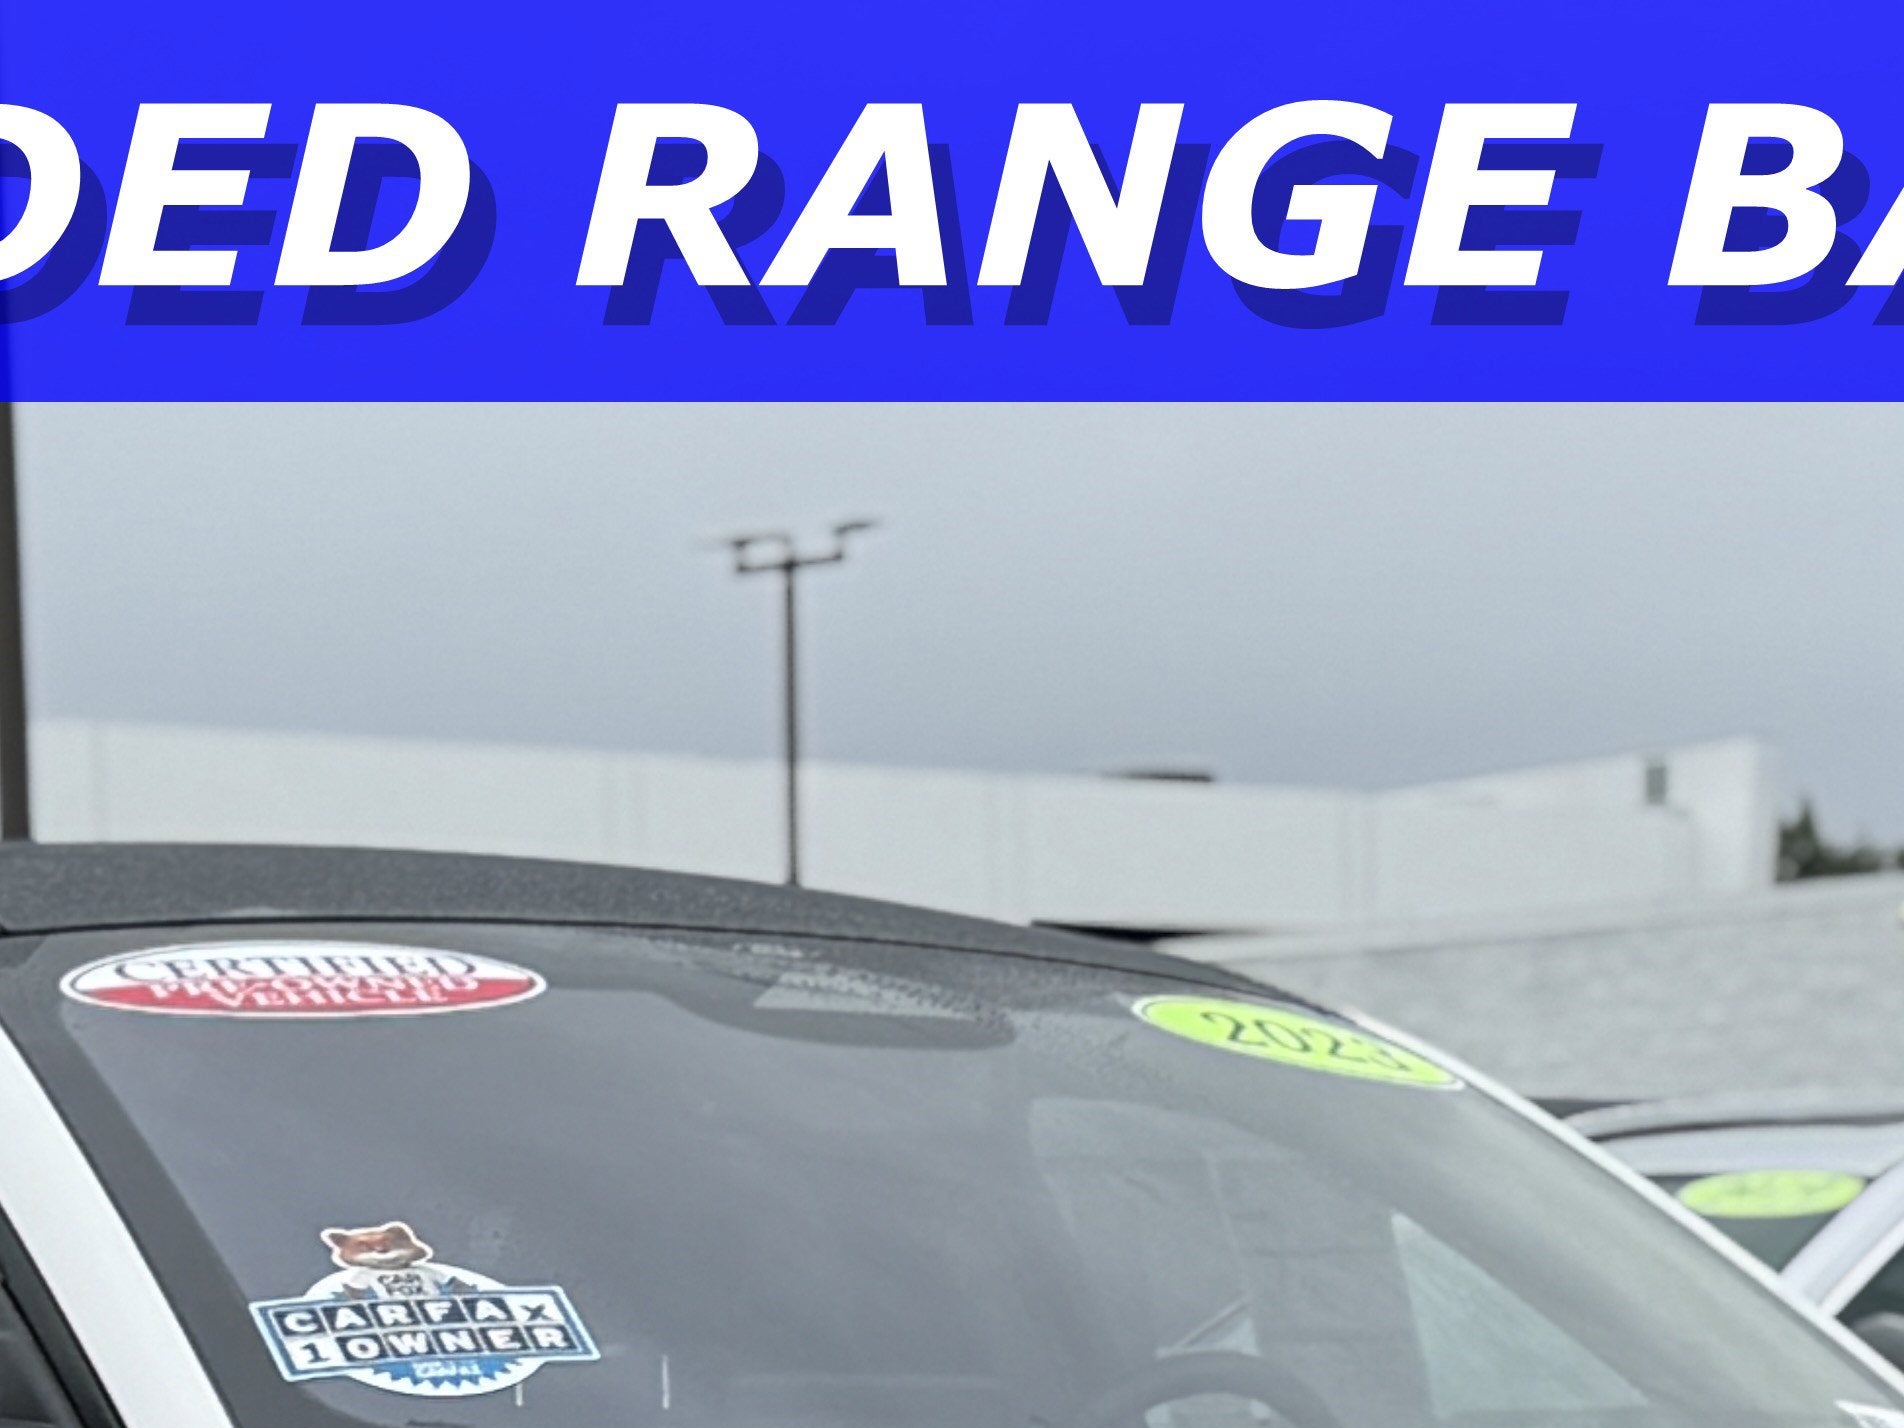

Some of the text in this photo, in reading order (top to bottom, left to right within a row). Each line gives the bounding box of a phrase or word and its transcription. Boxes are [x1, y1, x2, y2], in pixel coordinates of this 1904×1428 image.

[114, 955, 477, 980] CERTIFIED
[208, 982, 448, 1006] VEHICLE
[282, 1300, 555, 1333] CARFAX
[291, 1326, 572, 1364] 1 OWNER
